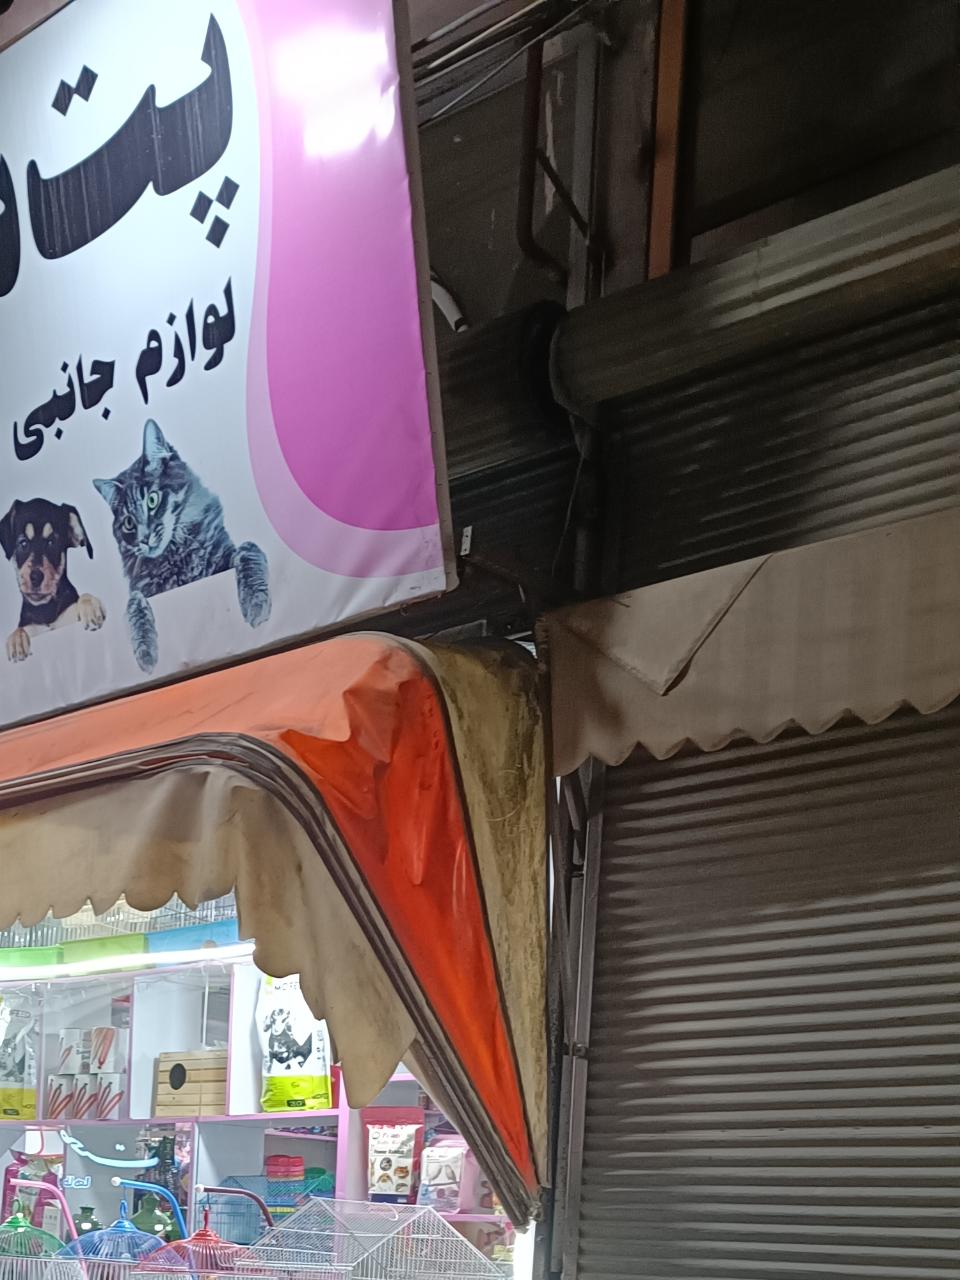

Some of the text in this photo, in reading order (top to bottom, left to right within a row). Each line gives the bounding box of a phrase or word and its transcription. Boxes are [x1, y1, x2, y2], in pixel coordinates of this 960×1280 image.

[26, 12, 240, 260] پت
[135, 275, 236, 406] لوازم
[12, 352, 116, 461] جانبی
